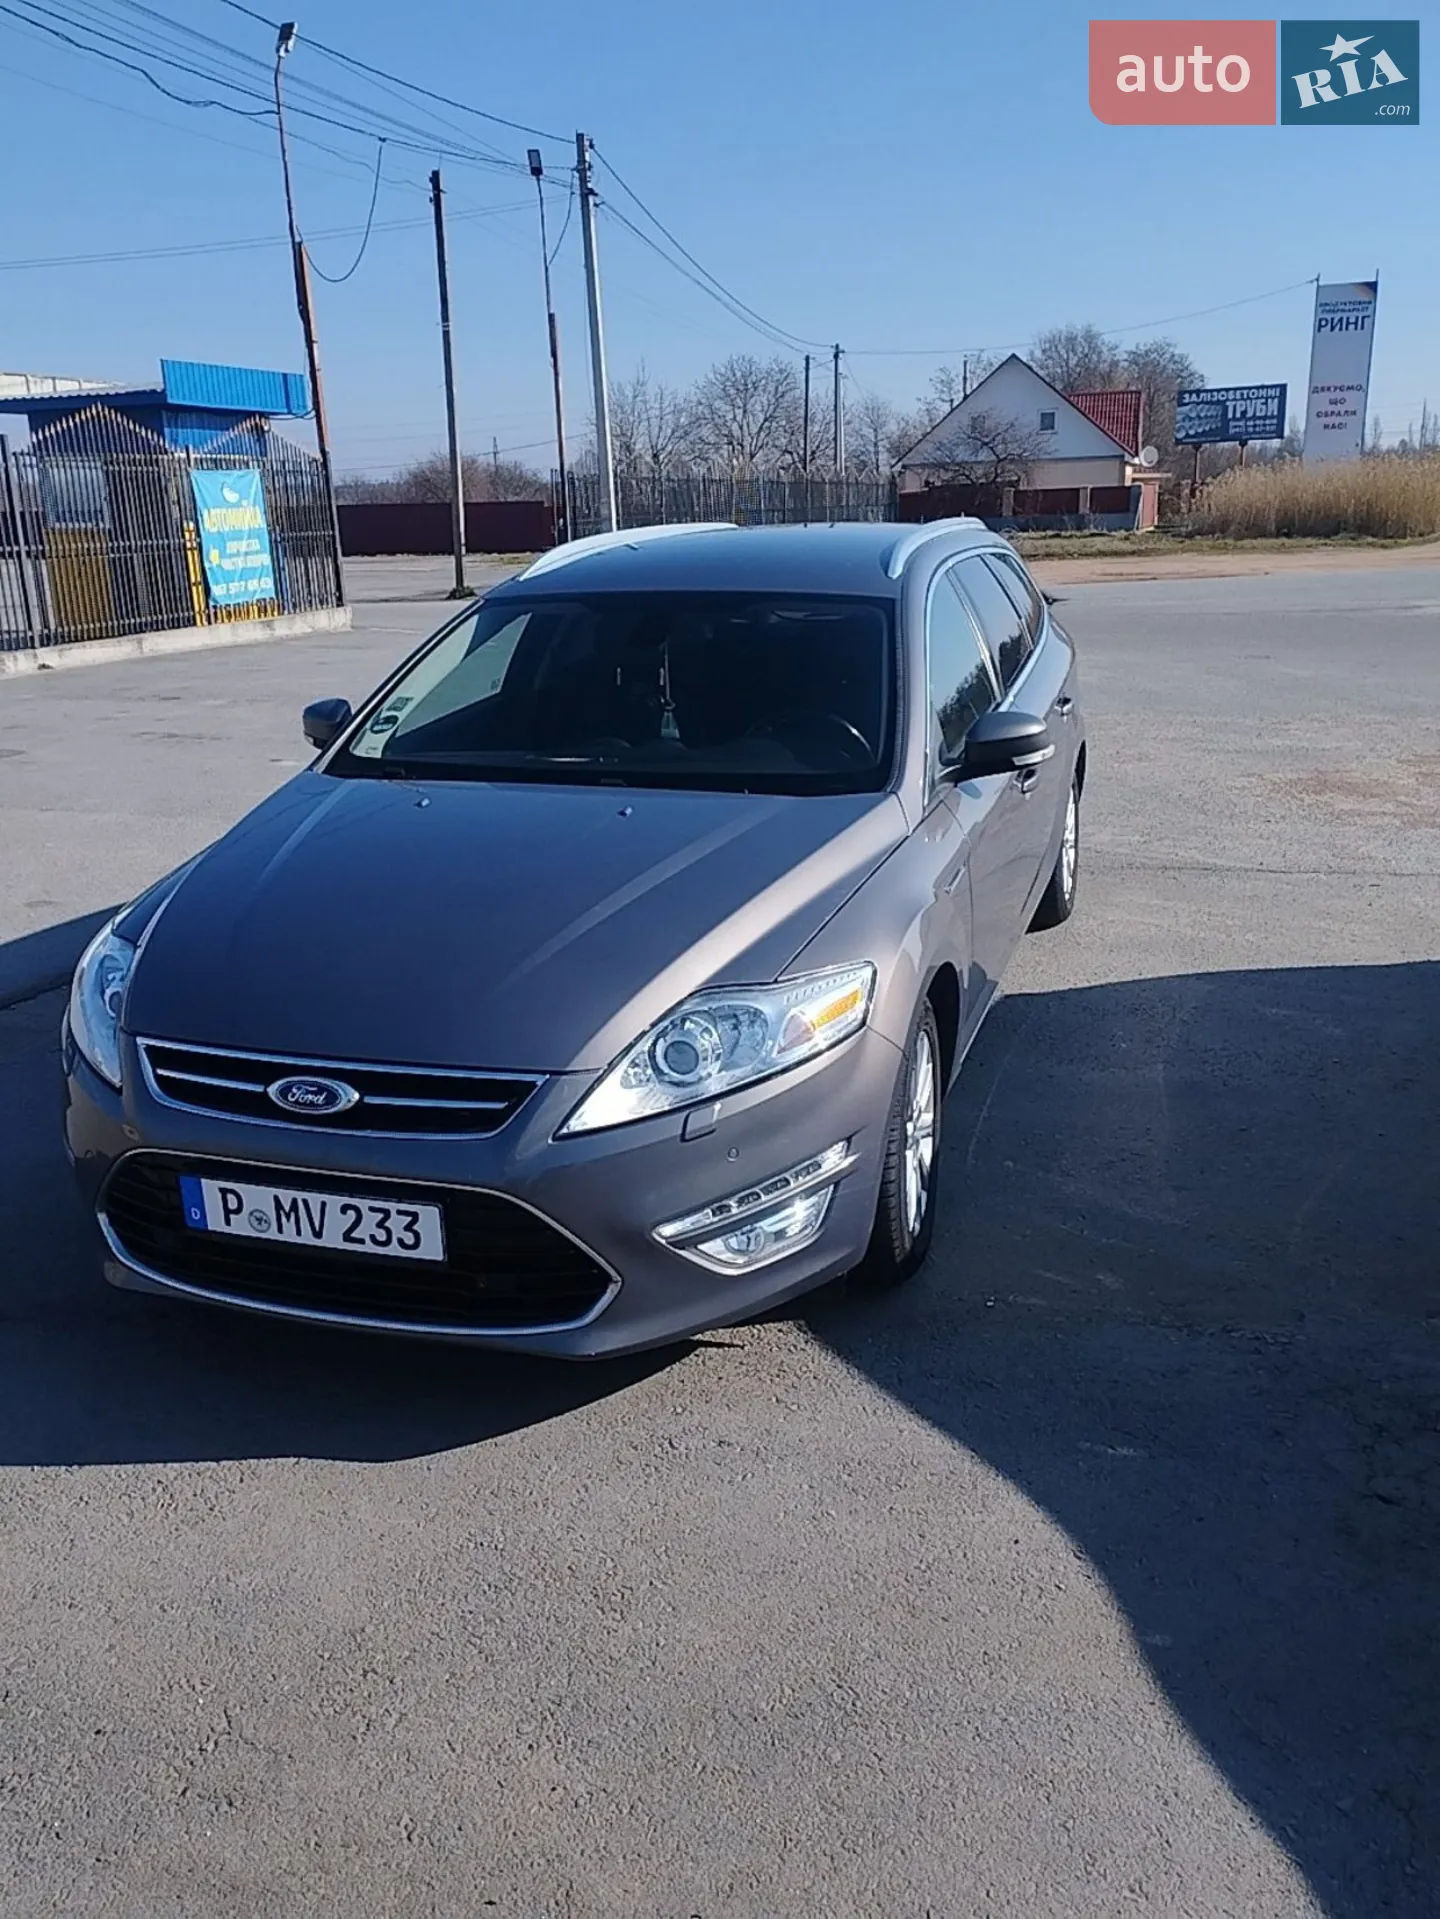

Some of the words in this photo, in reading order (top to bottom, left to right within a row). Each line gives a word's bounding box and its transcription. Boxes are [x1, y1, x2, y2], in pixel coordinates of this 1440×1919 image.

[1317, 315, 1371, 333] РИНГ
[1182, 387, 1281, 404] ЗАЛІЗОБЕТОННІ
[1328, 396, 1347, 406] ЩО
[1226, 397, 1279, 419] ТРУБИ
[1316, 409, 1357, 419] ОБРАЛИ
[287, 1083, 328, 1105] Ford
[217, 1187, 245, 1227] P
[272, 1194, 328, 1240] MV
[339, 1203, 422, 1251] 233
